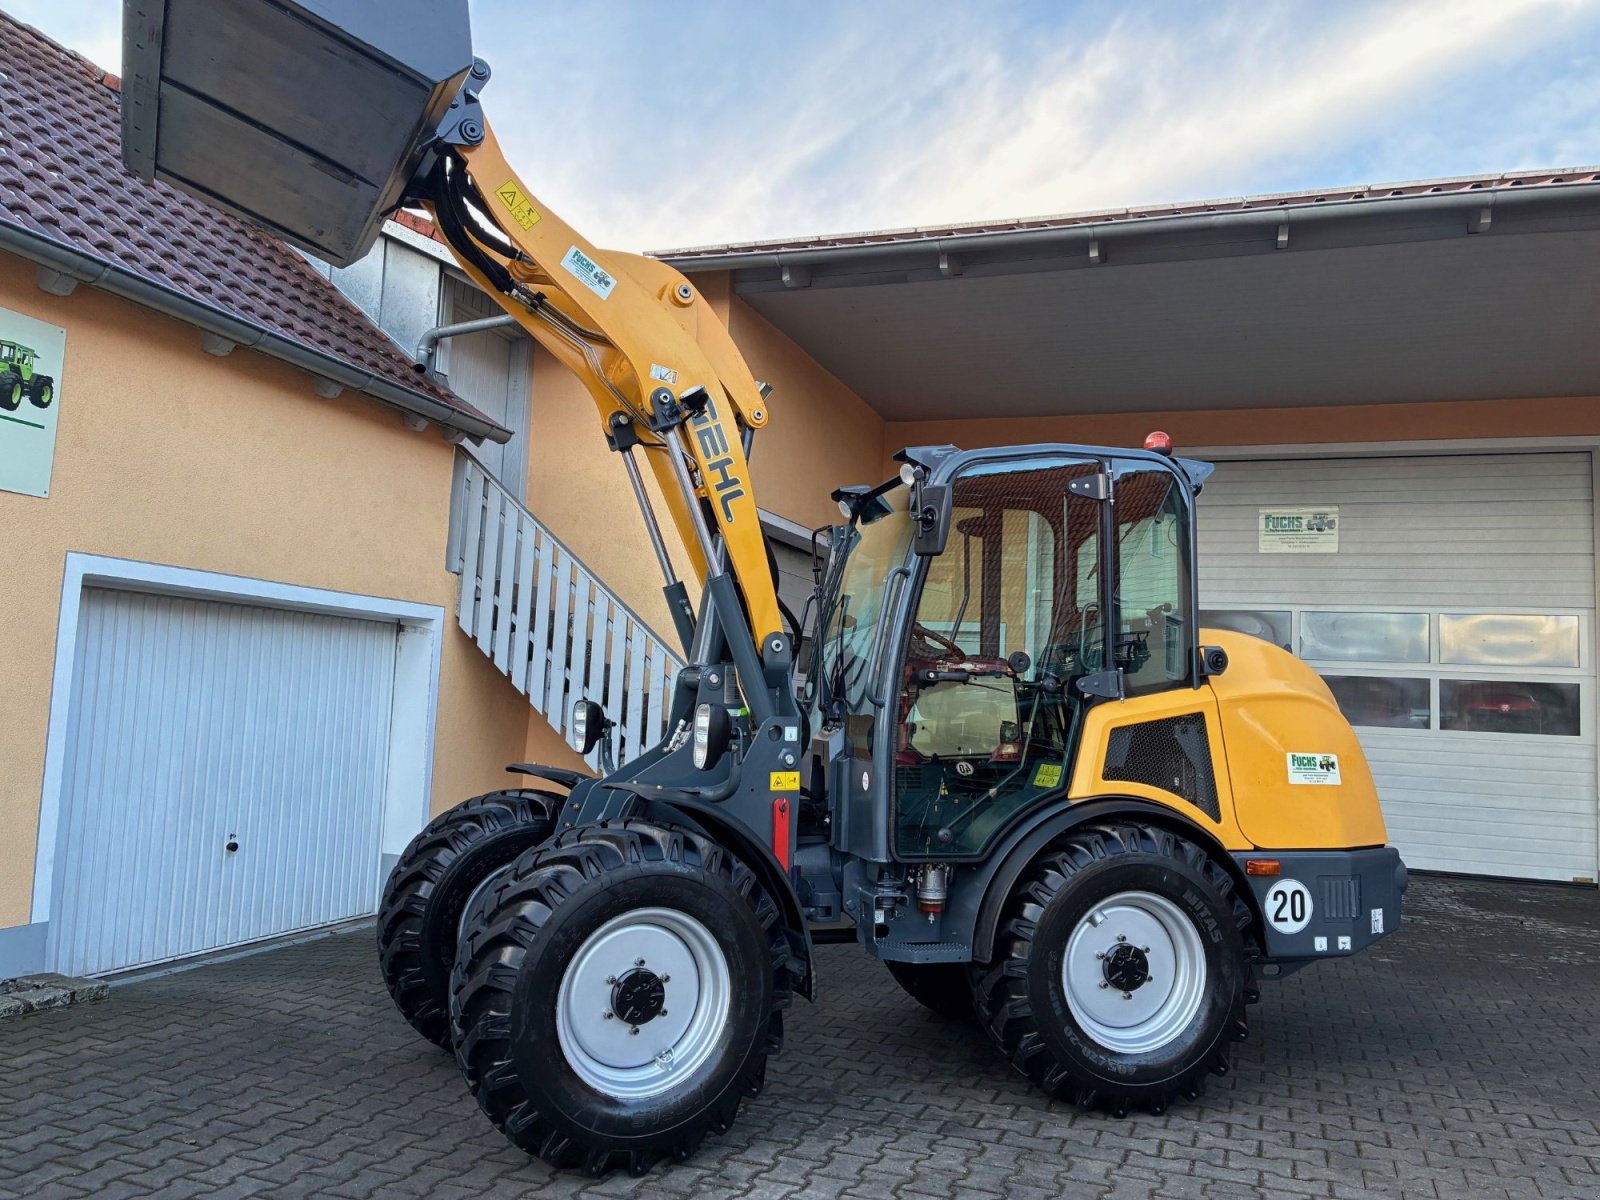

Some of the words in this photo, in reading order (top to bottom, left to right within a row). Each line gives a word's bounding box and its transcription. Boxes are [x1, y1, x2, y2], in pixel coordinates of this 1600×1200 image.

[572, 250, 596, 273] FUCHS
[1264, 514, 1303, 529] FUCHS
[1291, 754, 1317, 767] FUCHS
[1182, 888, 1224, 944] MITAS
[1273, 889, 1306, 923] 20
